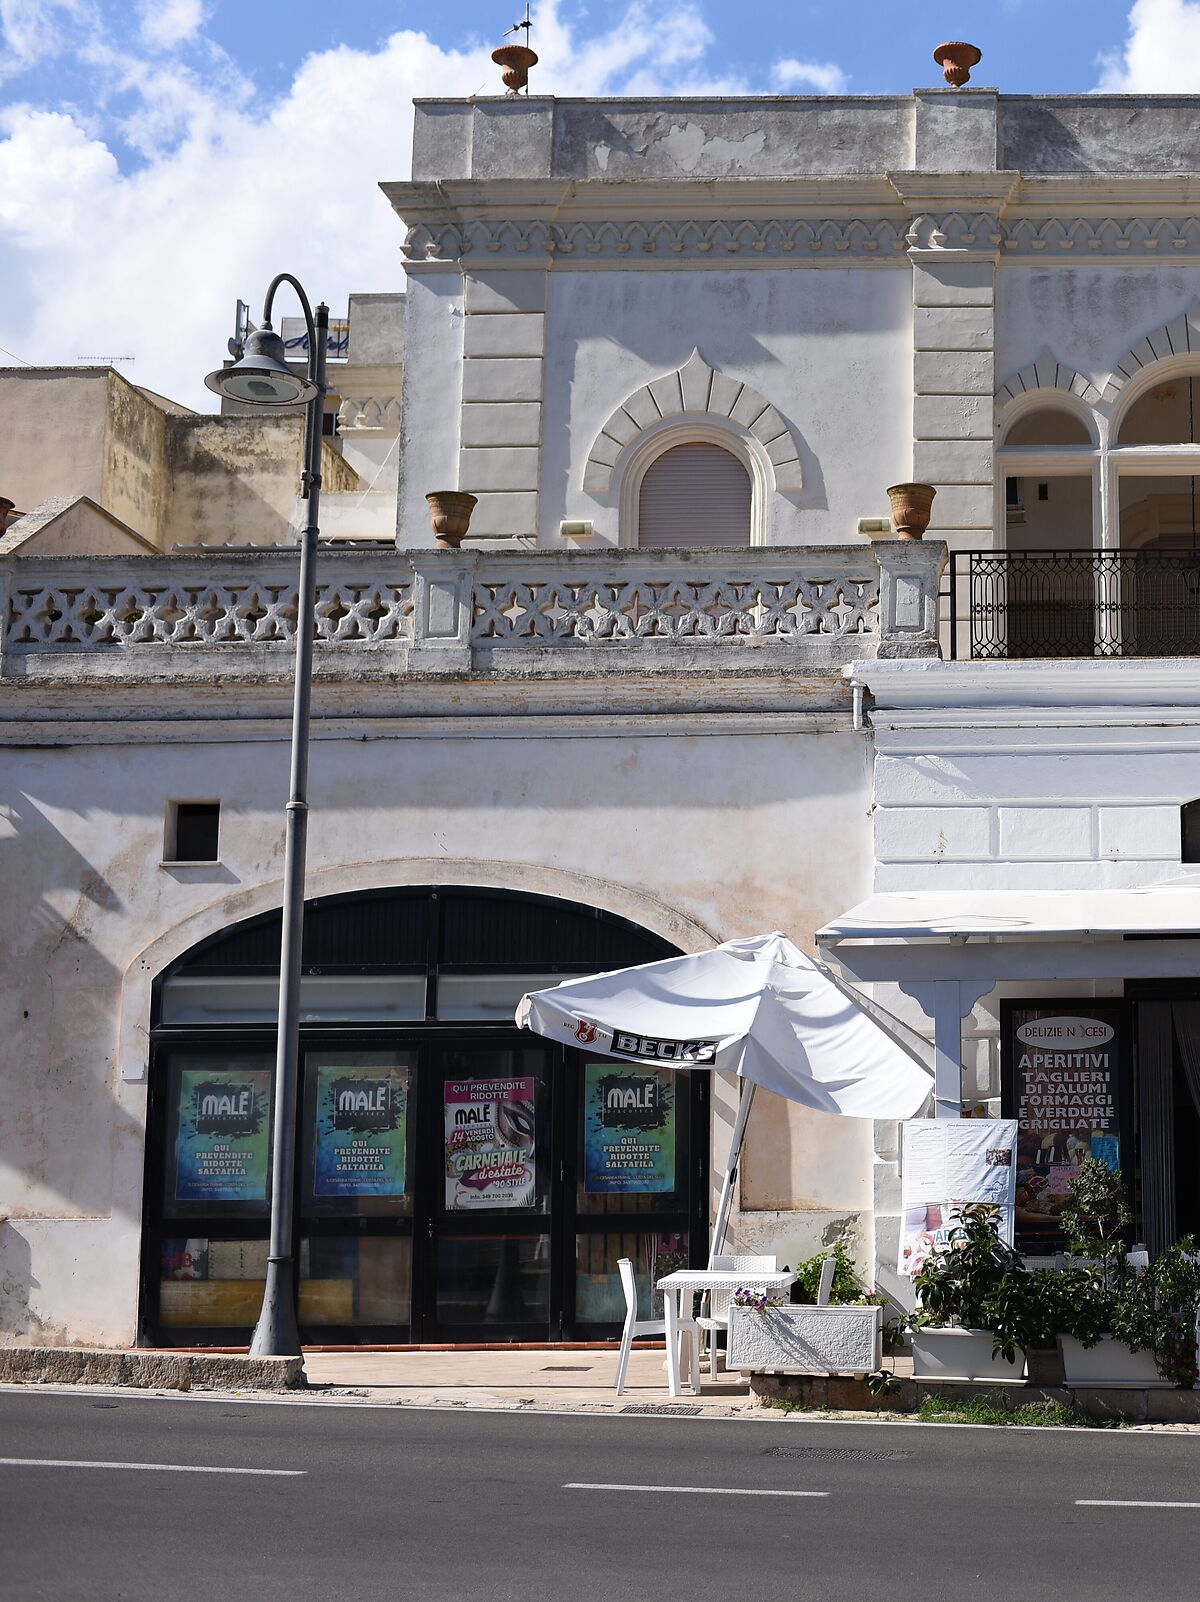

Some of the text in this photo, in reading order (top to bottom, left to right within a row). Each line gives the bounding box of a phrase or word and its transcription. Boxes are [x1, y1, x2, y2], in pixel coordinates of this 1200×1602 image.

[284, 332, 349, 351] Hel
[1025, 1027, 1062, 1037] DELIZIE
[618, 1034, 719, 1061] BECK'S
[1018, 1053, 1109, 1068] APERITIVI
[1022, 1072, 1110, 1082] TAGLIERI
[452, 1082, 526, 1093] QUI PREVENDITE
[1026, 1083, 1107, 1094] DI SALUMI
[470, 1091, 509, 1100] RIDOTTE
[1021, 1094, 1112, 1105] FORMAGGI
[1019, 1106, 1115, 1118] E VERDURE
[1018, 1118, 1110, 1129] GRIGLIATE
[452, 1131, 464, 1143] 14
[466, 1134, 494, 1142] AGOSTO
[456, 1150, 527, 1171] CARNEVALE
[336, 1163, 384, 1171] SALTAFILA
[479, 1164, 524, 1180] d'estate
[506, 1178, 526, 1187] STYLE
